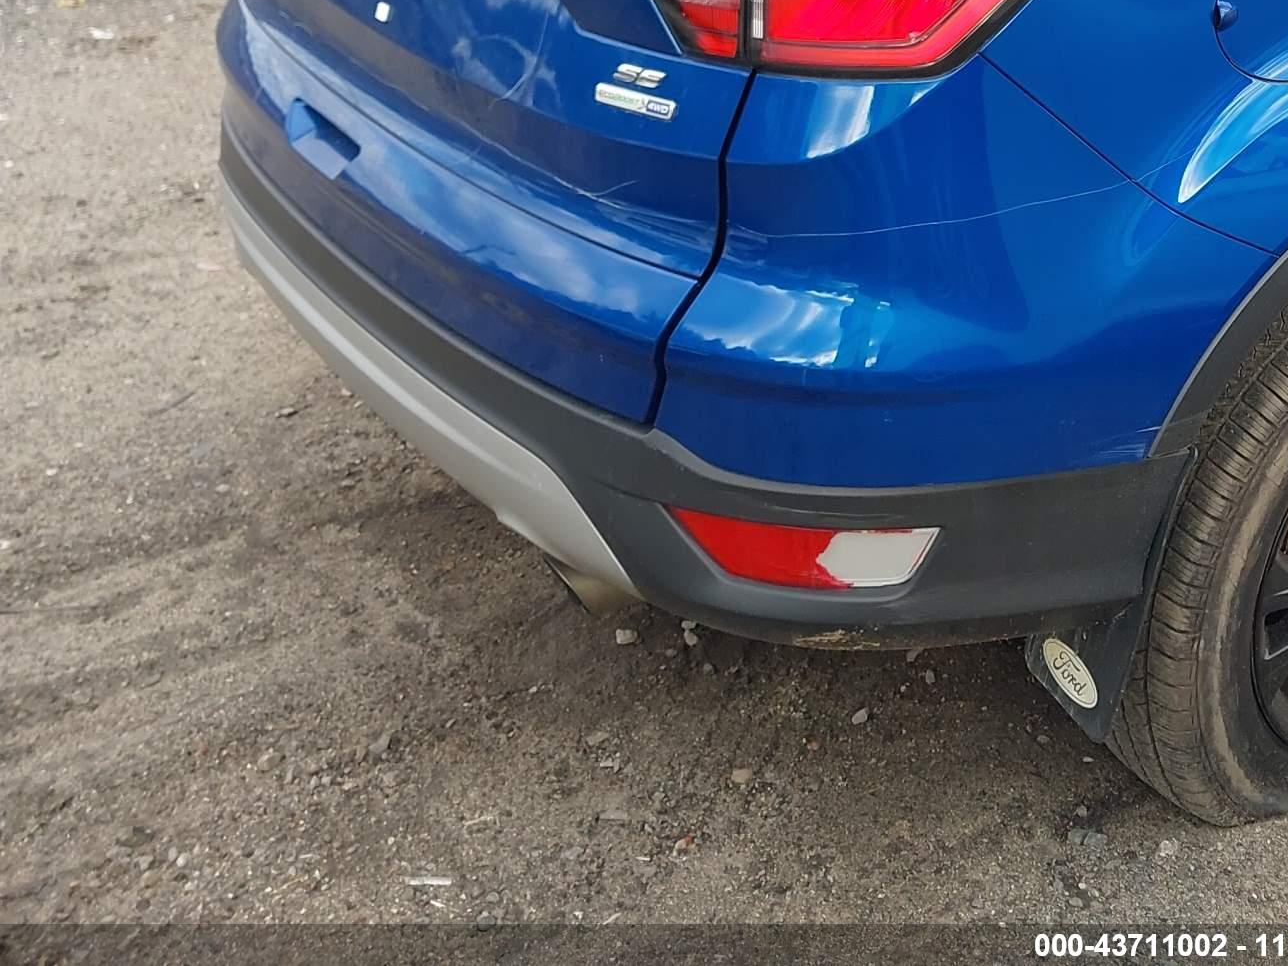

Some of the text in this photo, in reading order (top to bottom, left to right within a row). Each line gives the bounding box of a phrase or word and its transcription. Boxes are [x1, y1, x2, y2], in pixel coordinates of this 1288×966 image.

[613, 63, 667, 88] SE
[647, 102, 669, 114] 4WD
[1053, 650, 1087, 696] Ford
